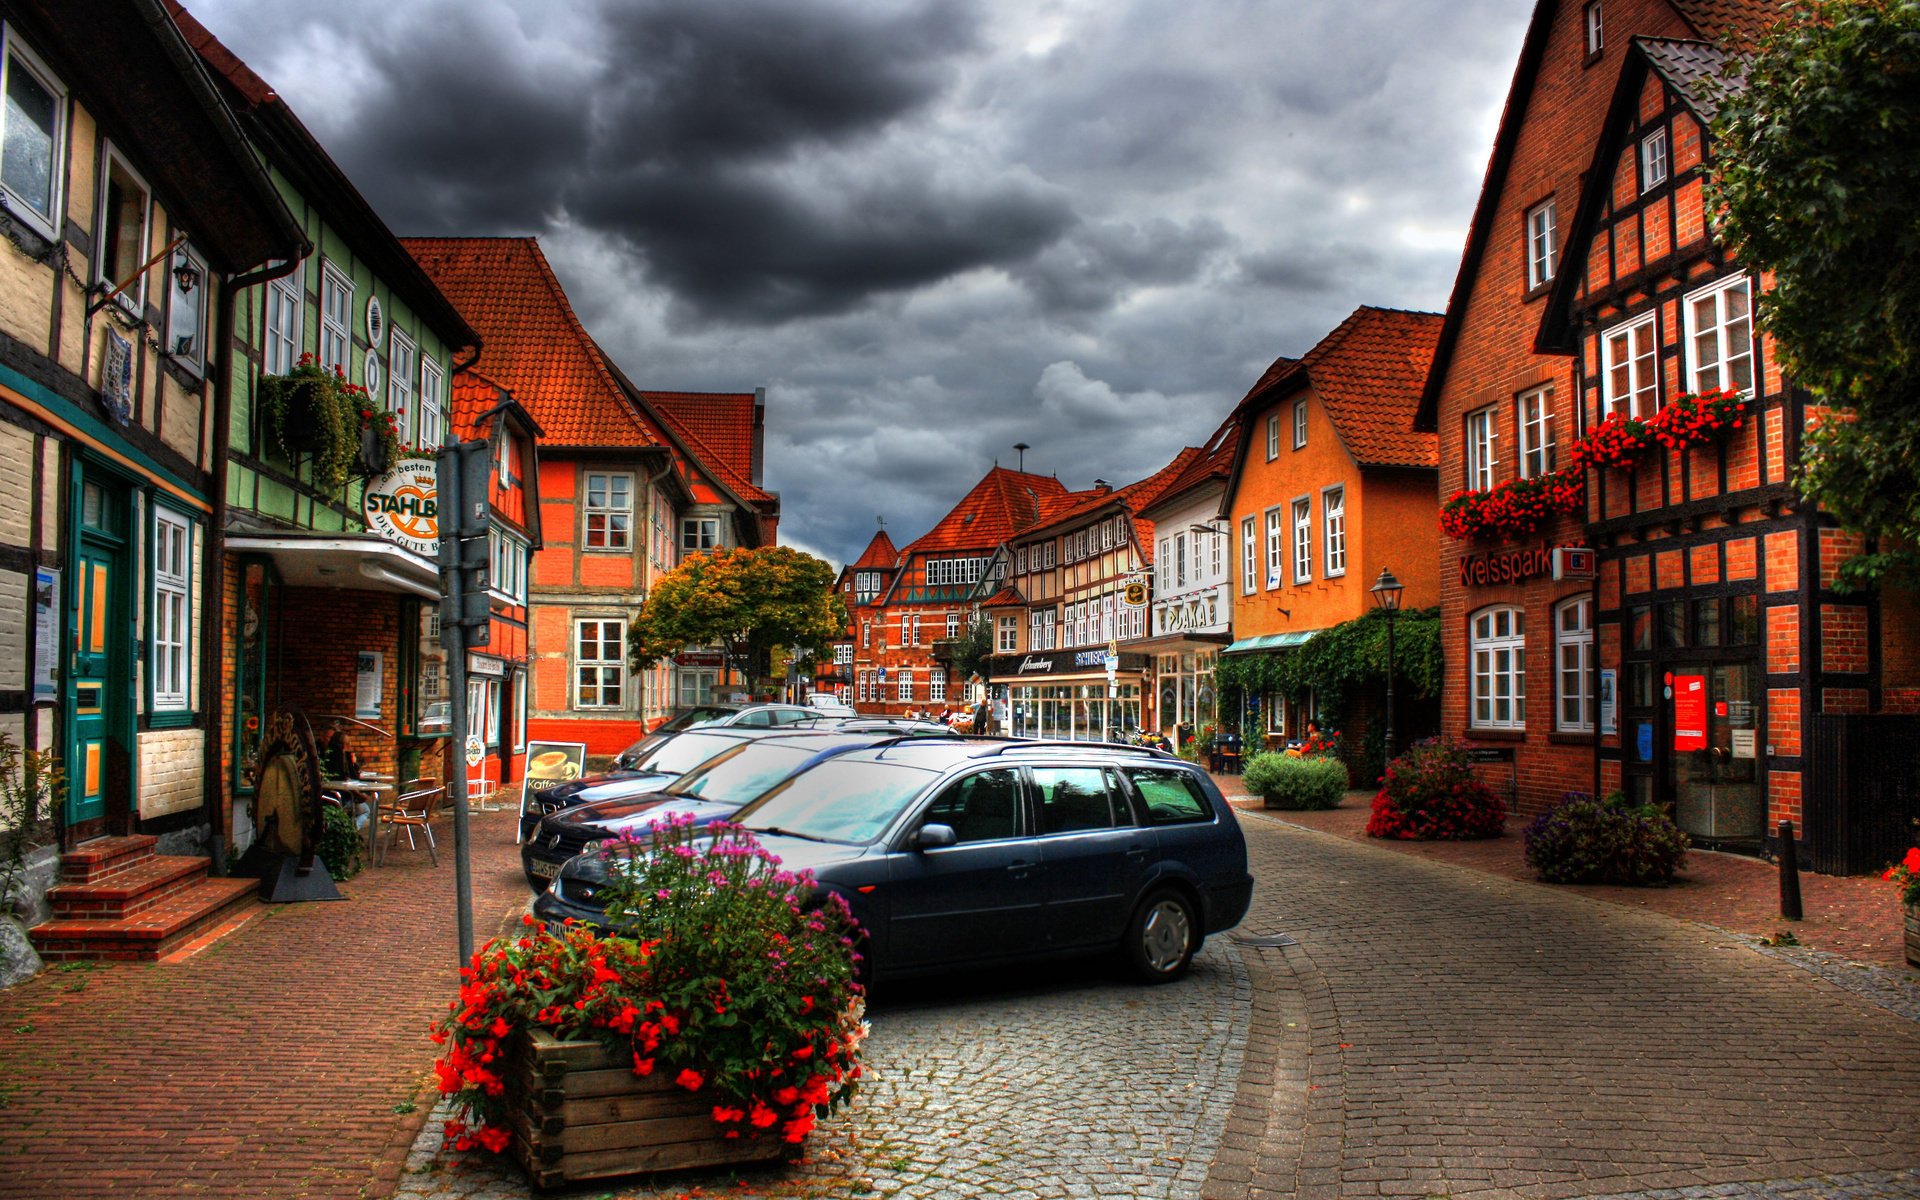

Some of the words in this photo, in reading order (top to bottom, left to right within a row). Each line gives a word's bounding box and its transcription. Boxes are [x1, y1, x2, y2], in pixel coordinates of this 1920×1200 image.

[397, 463, 431, 473] besten
[367, 493, 437, 518] STAHLB
[375, 515, 395, 537] DER
[396, 536, 427, 551] GUTE
[1460, 540, 1585, 587] Kreisspark
[1169, 604, 1207, 632] PLAKA
[1075, 650, 1109, 666] SCHLECK
